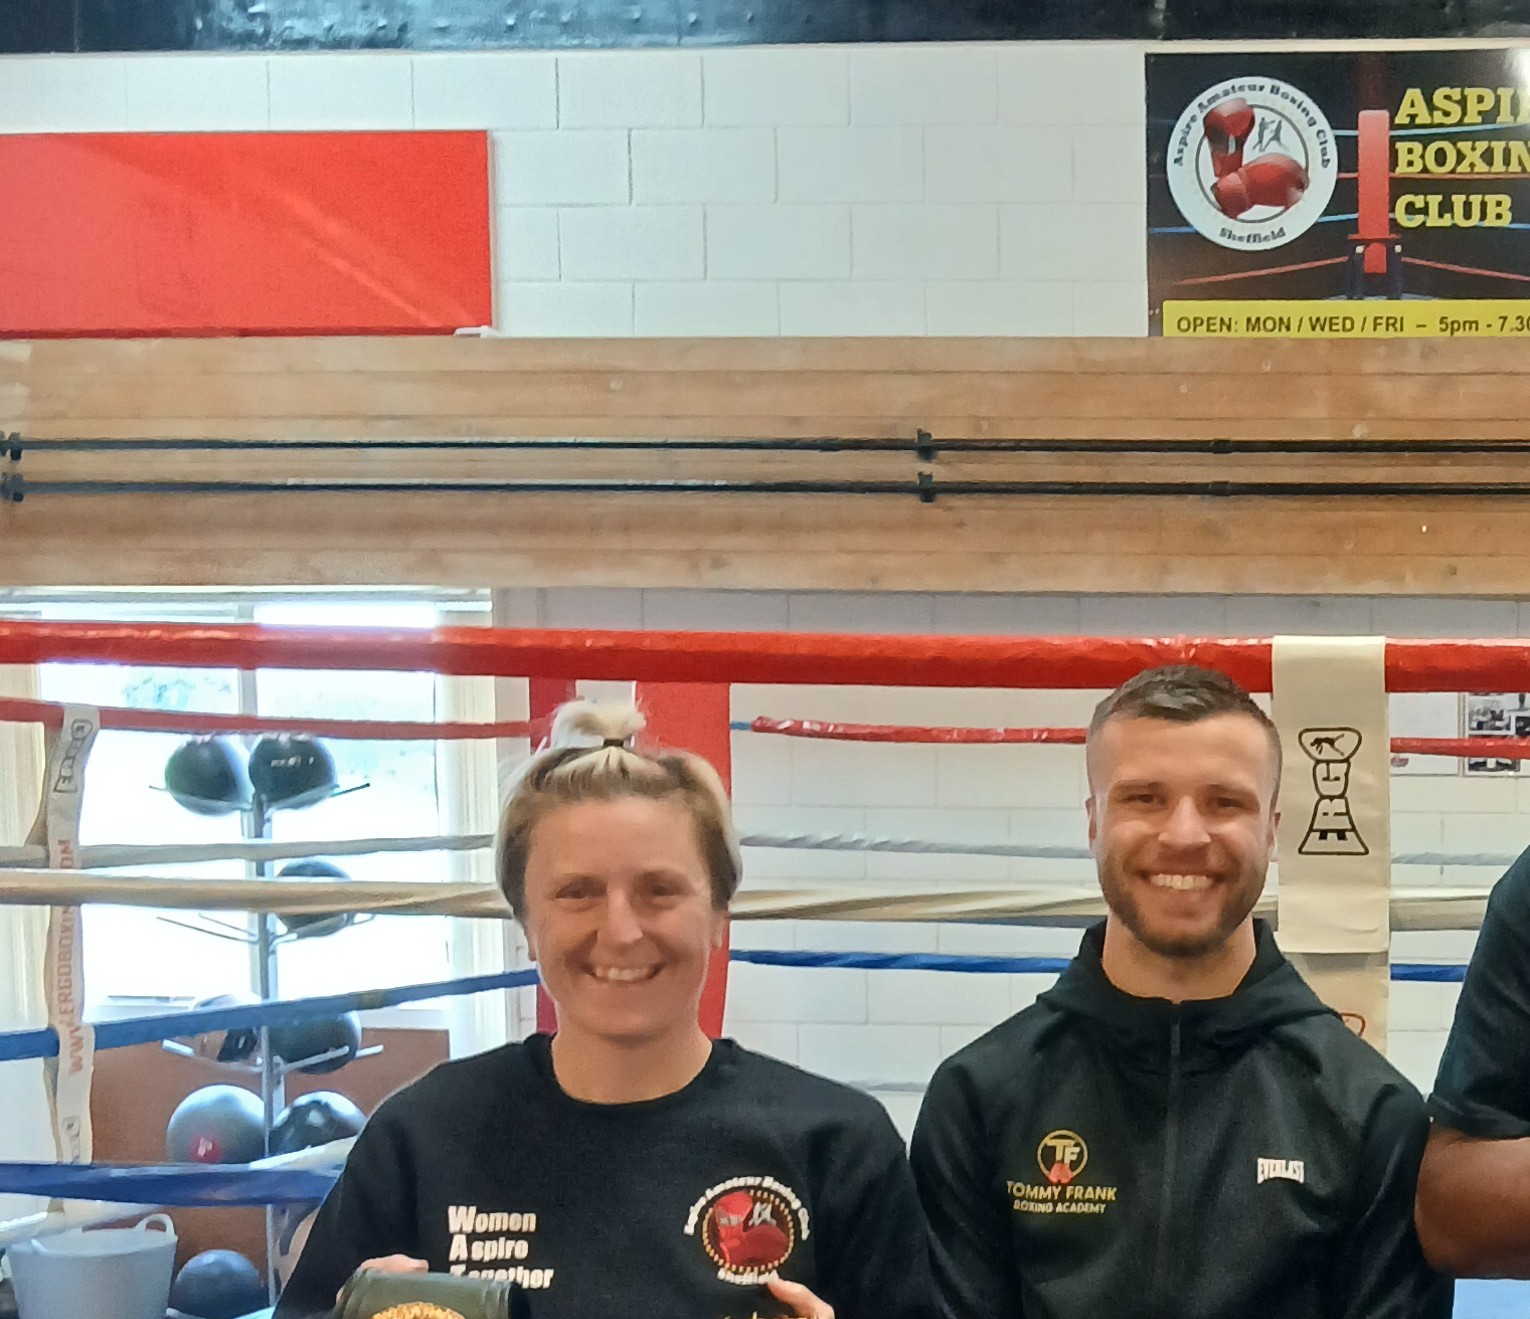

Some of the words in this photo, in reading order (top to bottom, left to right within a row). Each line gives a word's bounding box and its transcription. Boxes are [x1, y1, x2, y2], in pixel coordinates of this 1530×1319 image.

[1316, 128, 1331, 169] Club
[1394, 193, 1513, 228] CLUB
[1219, 226, 1287, 244] Sheffield
[1176, 315, 1238, 333] OPEN:
[1245, 315, 1292, 333] MON
[1308, 315, 1356, 333] WED
[1372, 315, 1404, 333] FRI
[1438, 315, 1480, 336] 5pm
[1006, 1180, 1062, 1200] TOMMY
[1065, 1185, 1118, 1201] FRANK
[1013, 1199, 1054, 1213] BOXING
[1055, 1202, 1107, 1214] ACADEMY
[447, 1205, 537, 1234] Women
